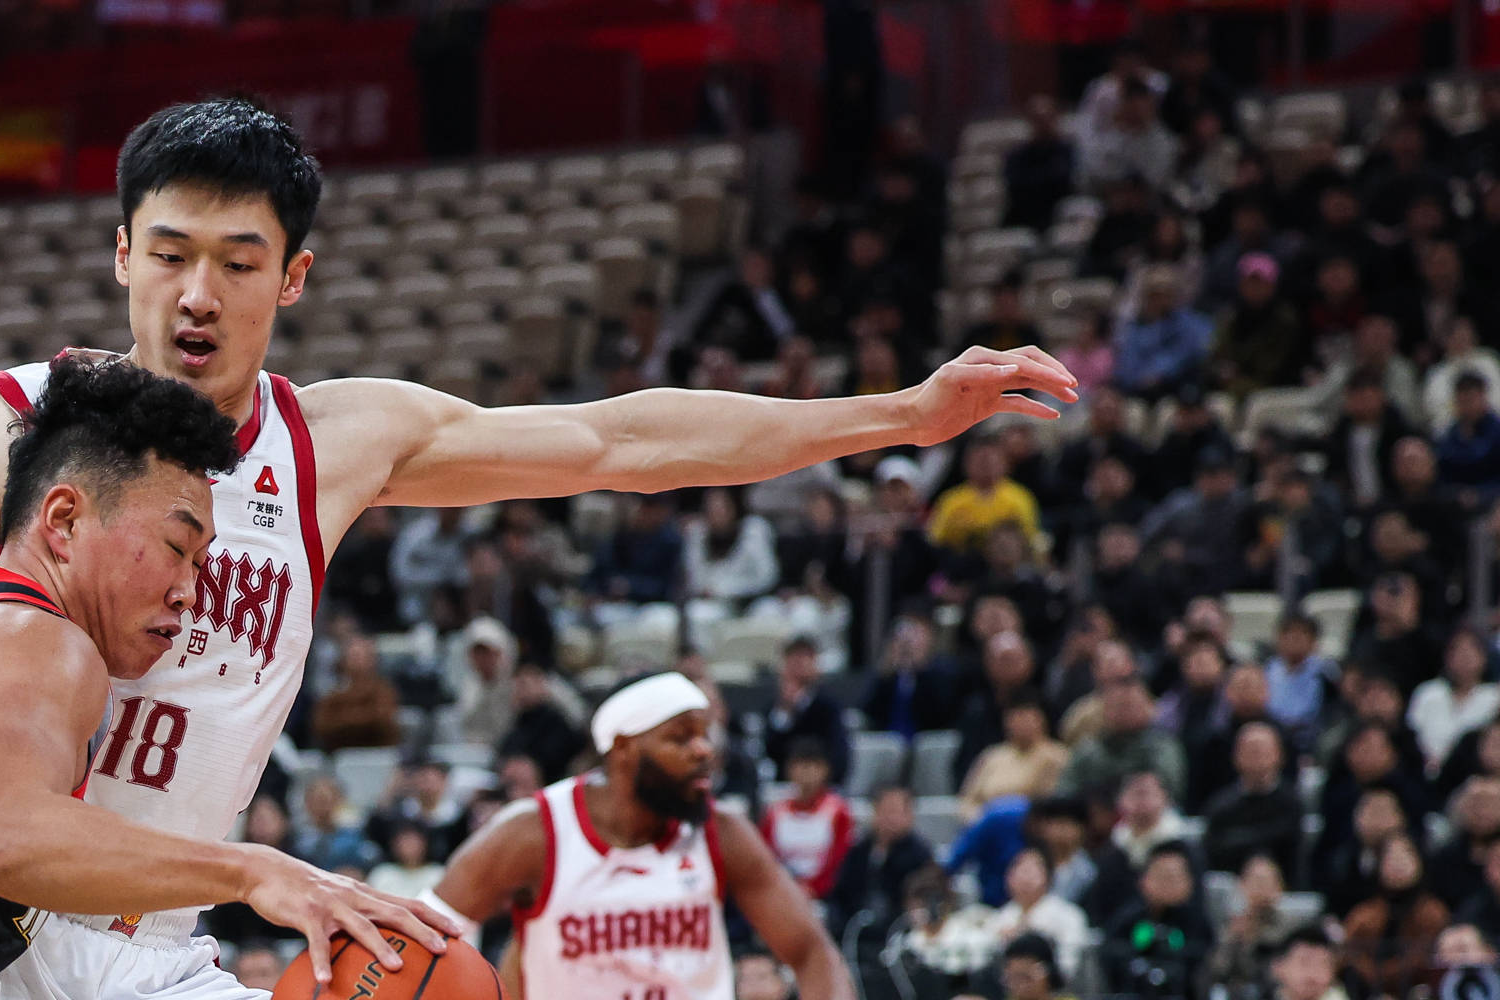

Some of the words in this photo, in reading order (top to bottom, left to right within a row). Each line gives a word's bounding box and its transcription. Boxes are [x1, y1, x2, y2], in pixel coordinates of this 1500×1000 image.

[247, 500, 284, 517] 广发银行
[253, 515, 275, 528] CGB
[189, 549, 293, 670] NXI
[94, 695, 191, 792] 18
[558, 904, 711, 960] SHANXI
